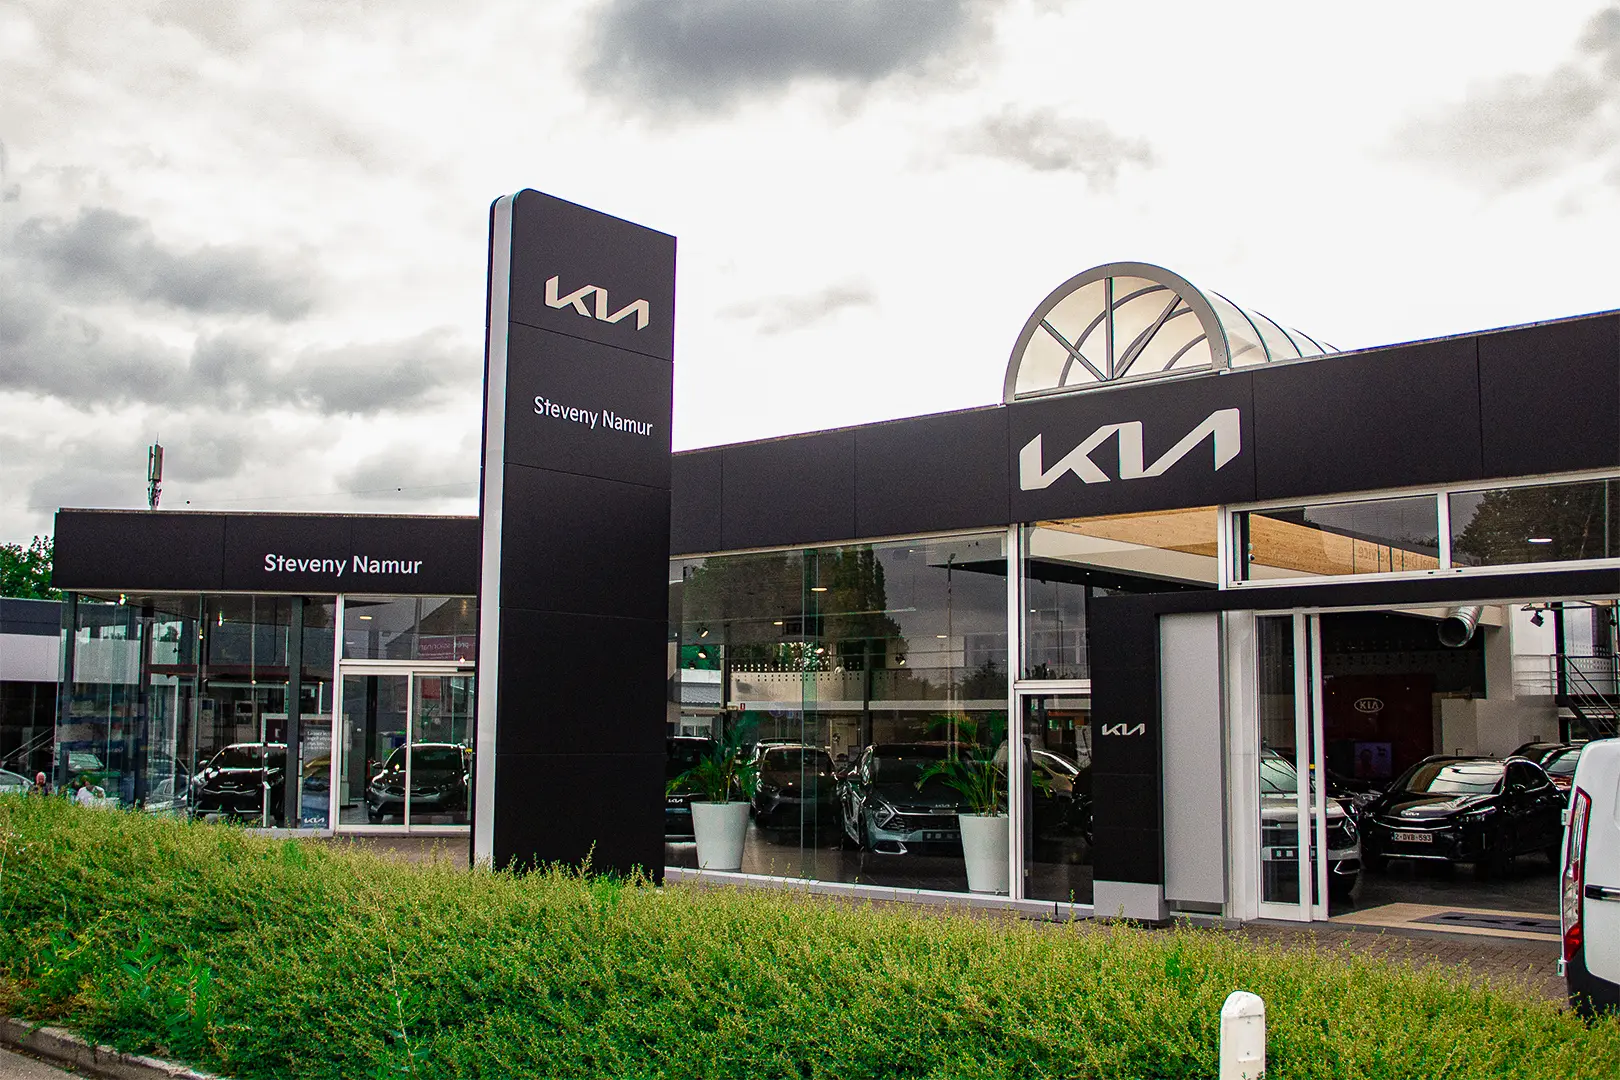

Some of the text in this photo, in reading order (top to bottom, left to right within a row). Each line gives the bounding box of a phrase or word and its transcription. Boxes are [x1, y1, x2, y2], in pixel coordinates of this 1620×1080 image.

[545, 275, 650, 331] KIA
[533, 395, 653, 436] Steveny Namur
[1019, 407, 1241, 491] KIA
[264, 553, 422, 577] Steveny Namur
[1360, 700, 1379, 710] KIA
[1101, 723, 1146, 736] KIA
